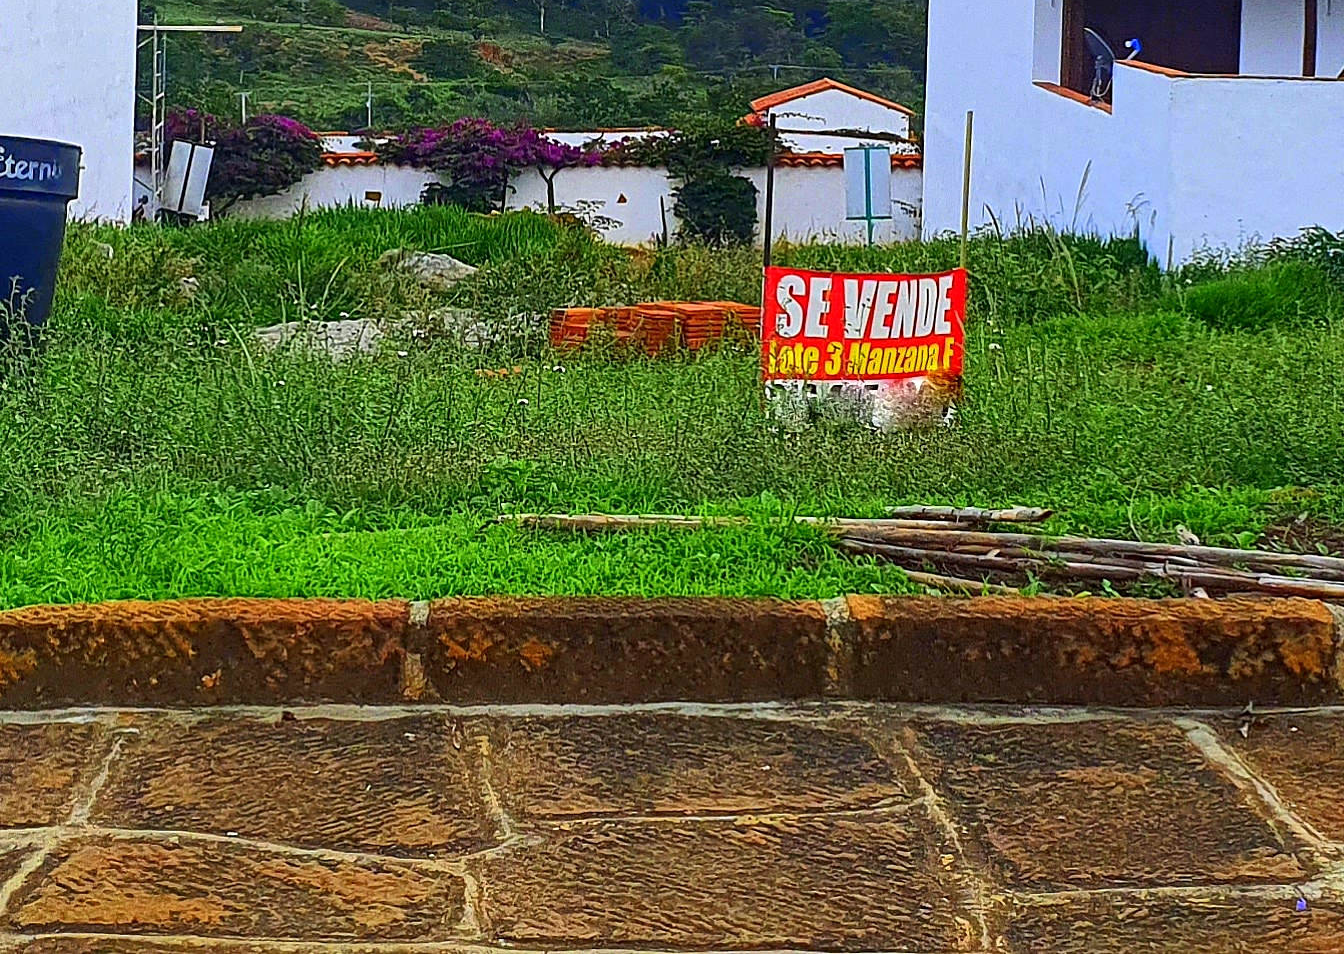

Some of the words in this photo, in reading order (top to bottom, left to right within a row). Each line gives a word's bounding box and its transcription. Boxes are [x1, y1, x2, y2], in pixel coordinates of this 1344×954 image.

[776, 275, 832, 338] SE
[843, 276, 953, 339] VENDE
[824, 341, 844, 375] 3
[847, 342, 940, 375] Manzana
